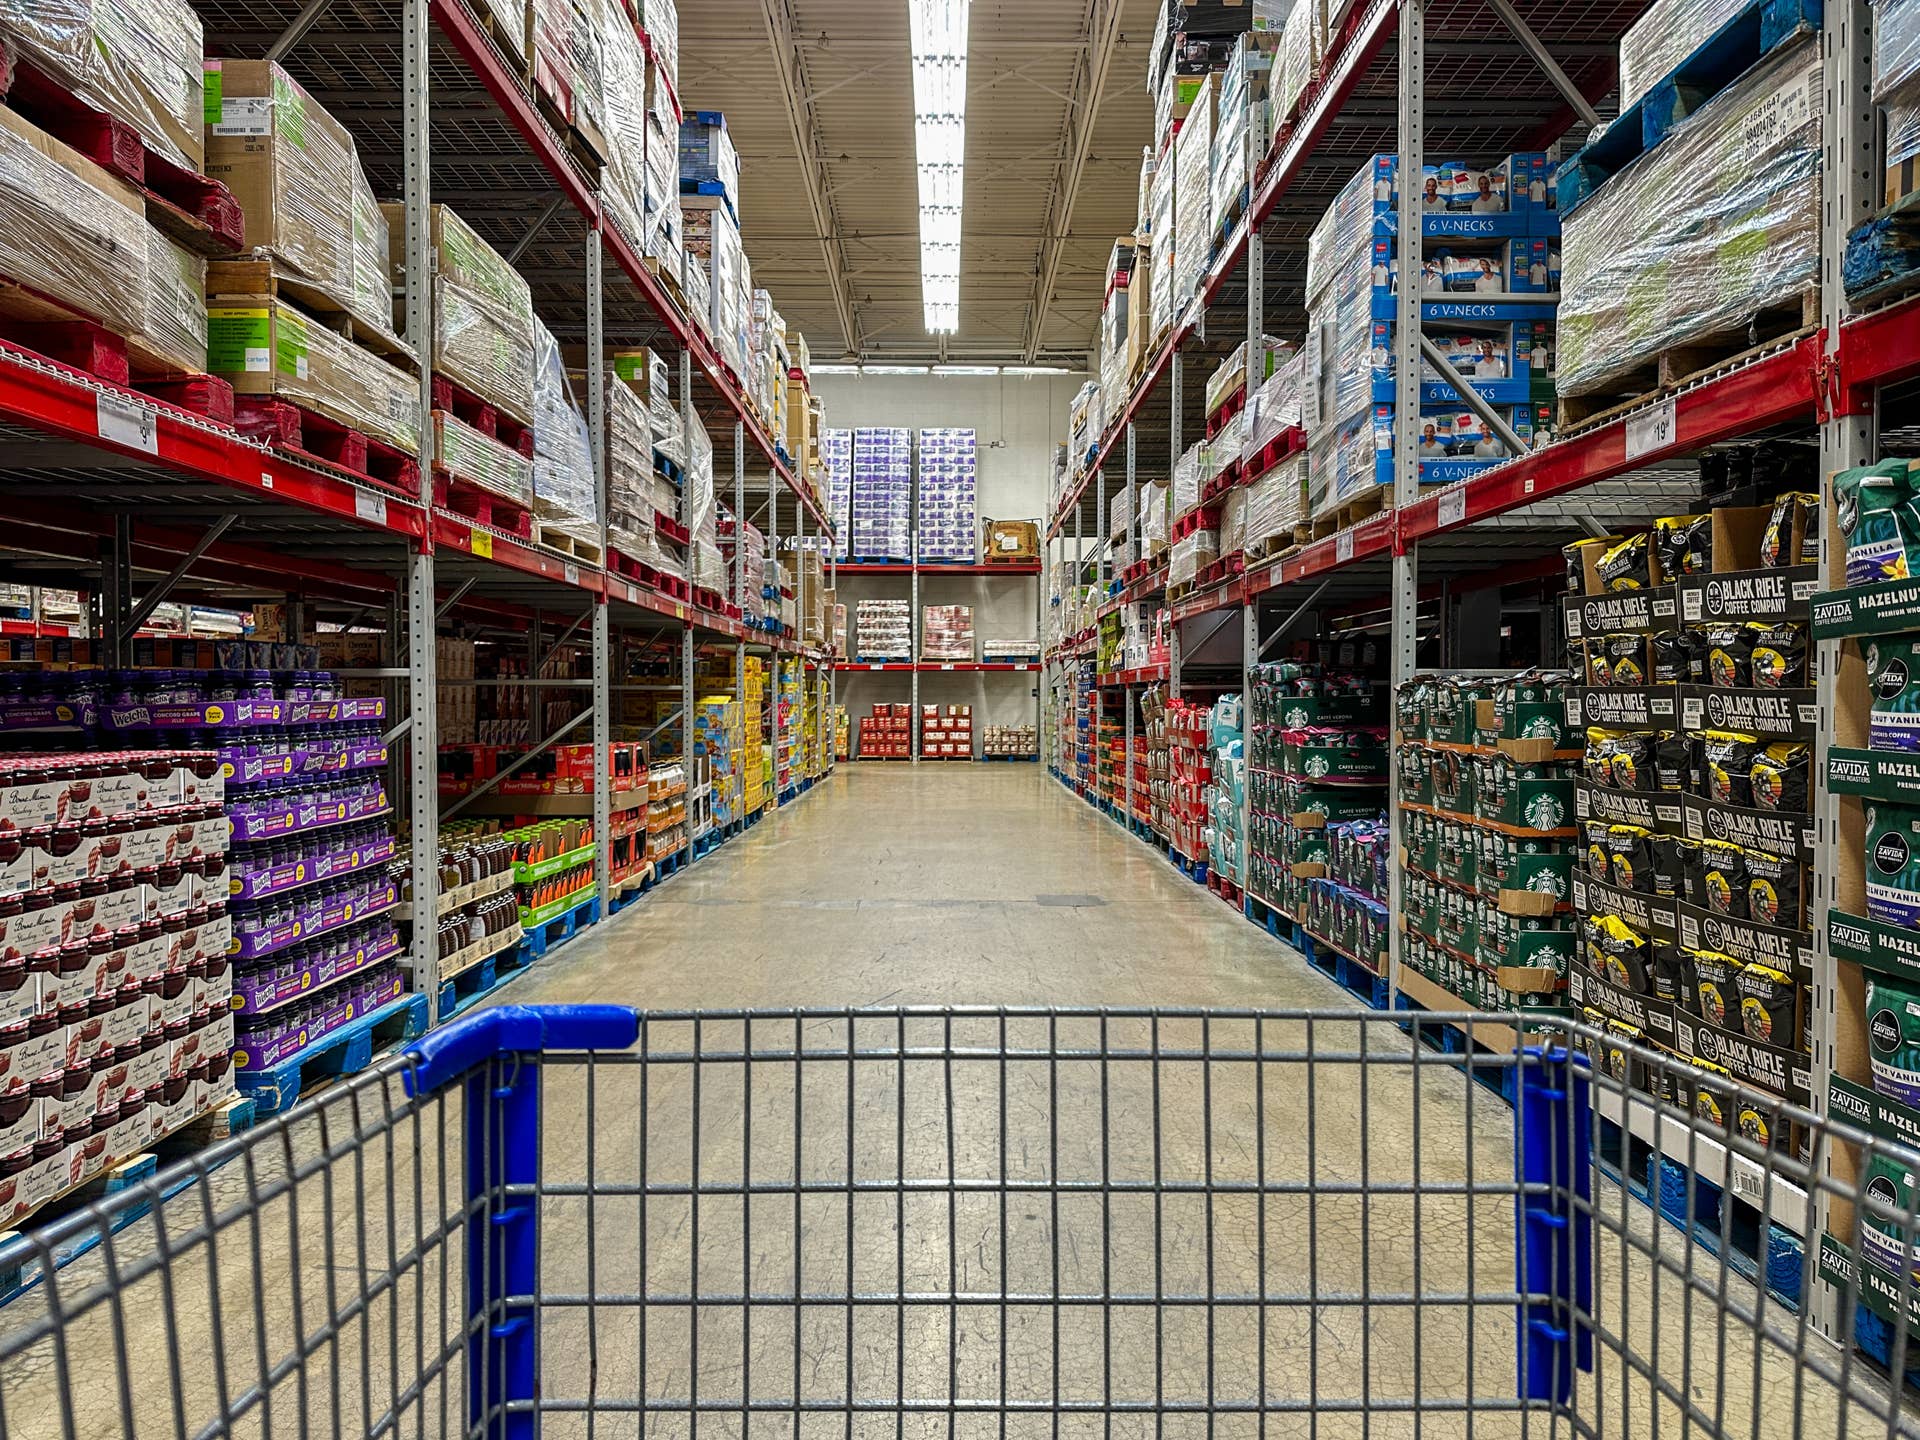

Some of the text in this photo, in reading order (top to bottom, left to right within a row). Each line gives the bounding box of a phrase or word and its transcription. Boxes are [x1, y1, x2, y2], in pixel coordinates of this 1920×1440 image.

[1429, 220, 1495, 231] 6 V-NECKS
[1430, 305, 1496, 316] 6 V-NECKS
[1430, 388, 1437, 399] 6
[1432, 467, 1440, 478] 6
[1851, 543, 1895, 559] VANILLA
[1722, 576, 1786, 600] BLACK RIFLE
[1598, 599, 1624, 618] BLACK
[1623, 597, 1649, 615] RIFLE
[1724, 598, 1786, 615] COFFEE COMPANY
[1814, 602, 1852, 620] ZAVIDA
[1877, 608, 1905, 619] PREMIUM
[1601, 615, 1650, 630] COFFEE COMPANY
[1599, 693, 1624, 710] BLACK
[1623, 693, 1647, 711] RIFLE
[1723, 695, 1791, 718] BLACK RIFLE
[114, 708, 149, 725] Welch's
[1601, 711, 1648, 723] COFFEE COMPANY
[1727, 716, 1793, 733] COFFEE COMPANY
[1830, 762, 1870, 777] ZAVIDA
[1601, 791, 1627, 813] BLACK
[1624, 797, 1651, 816] RIFLE
[1606, 809, 1625, 822] COFFEE
[1626, 813, 1655, 828] COMPANY
[1723, 811, 1795, 841] BLACK RIFLE
[1729, 831, 1797, 857] COFFEE COMPANY
[1878, 847, 1904, 859] ZAVIDA
[1600, 887, 1648, 917] BLACK RIFLE
[1889, 907, 1908, 917] COFFEE
[1721, 922, 1791, 958] BLACK RIFLE
[1830, 924, 1871, 947] ZAVIDA
[1726, 942, 1792, 973] COFFEE COMPANY
[1873, 1023, 1897, 1037] ZAVIDA
[1715, 1033, 1785, 1076] BLACK RIFLE
[1720, 1054, 1786, 1091] COFFEE COMPANY
[1830, 1089, 1871, 1118] ZAVIDA
[1870, 1189, 1895, 1207] ZAVIDA
